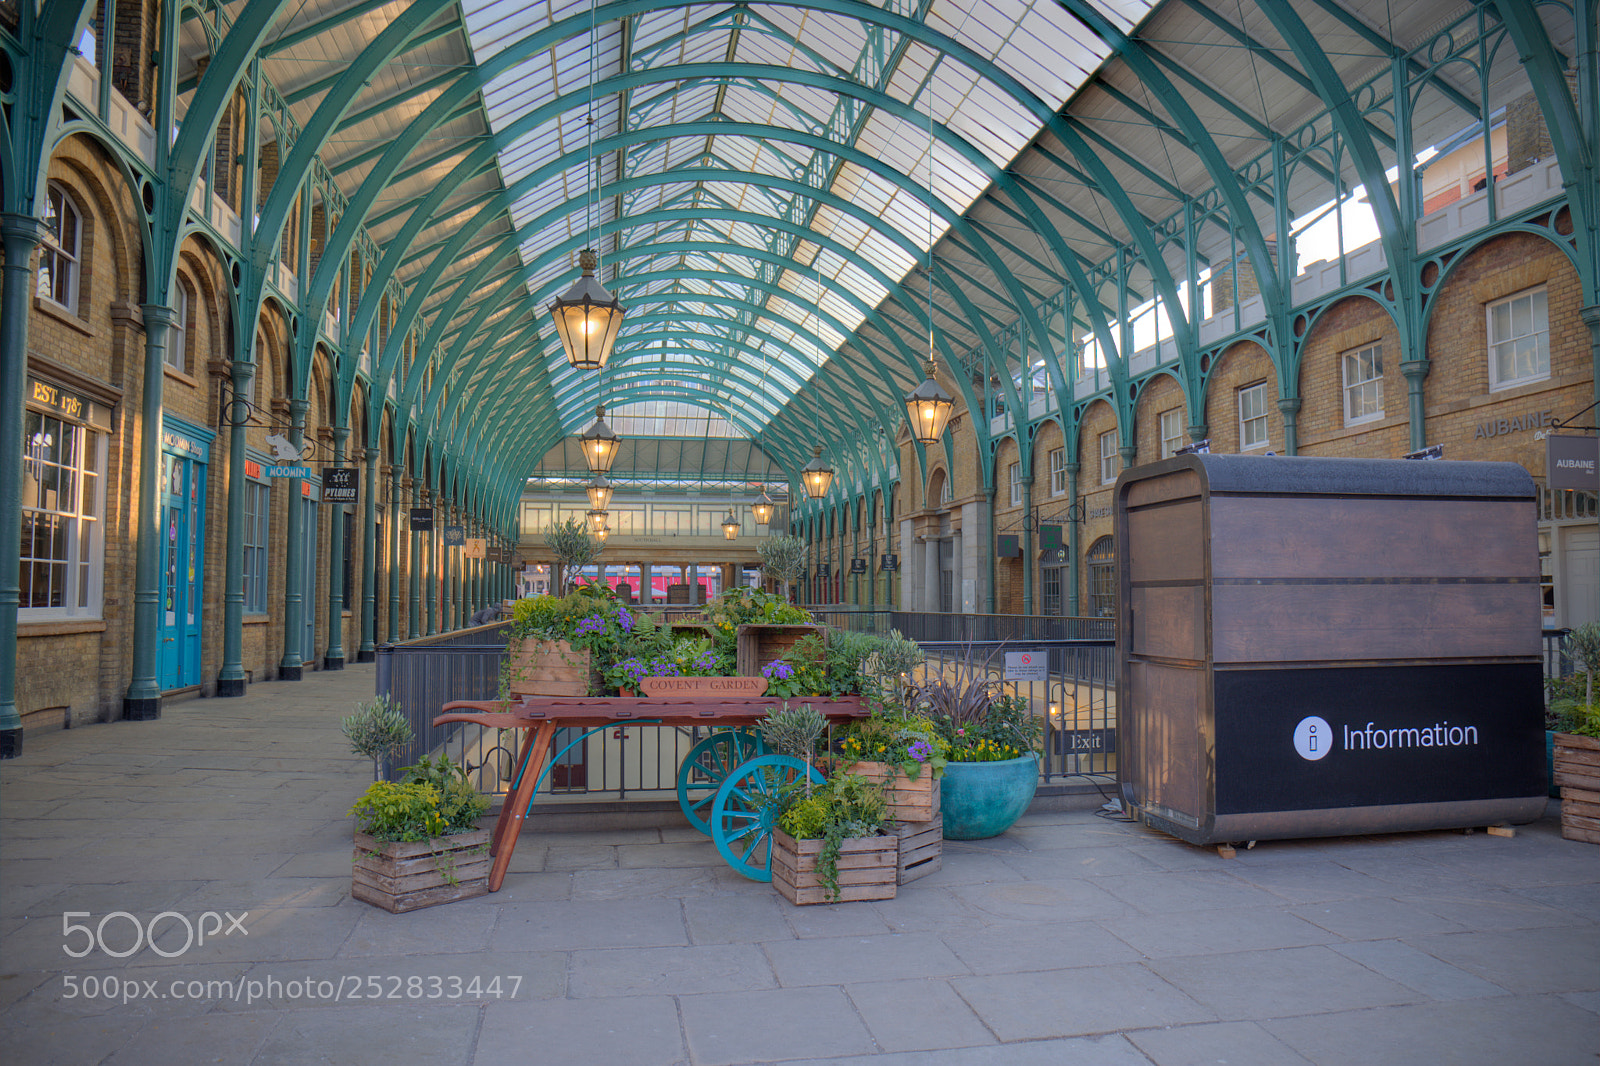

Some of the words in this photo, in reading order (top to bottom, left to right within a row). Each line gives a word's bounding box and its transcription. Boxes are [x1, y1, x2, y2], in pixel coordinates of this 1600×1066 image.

[33, 381, 58, 406] EST.
[61, 396, 82, 417] 1787
[1474, 409, 1552, 440] AUBAINE
[164, 432, 190, 452] MOOMIN
[270, 467, 306, 477] MOOMIN
[1556, 459, 1595, 469] AUBAINE
[324, 488, 356, 498] PYLONES
[649, 680, 700, 690] COVENT
[710, 680, 759, 690] GARDEN
[1070, 733, 1101, 749] Exit
[1343, 721, 1478, 750] Information
